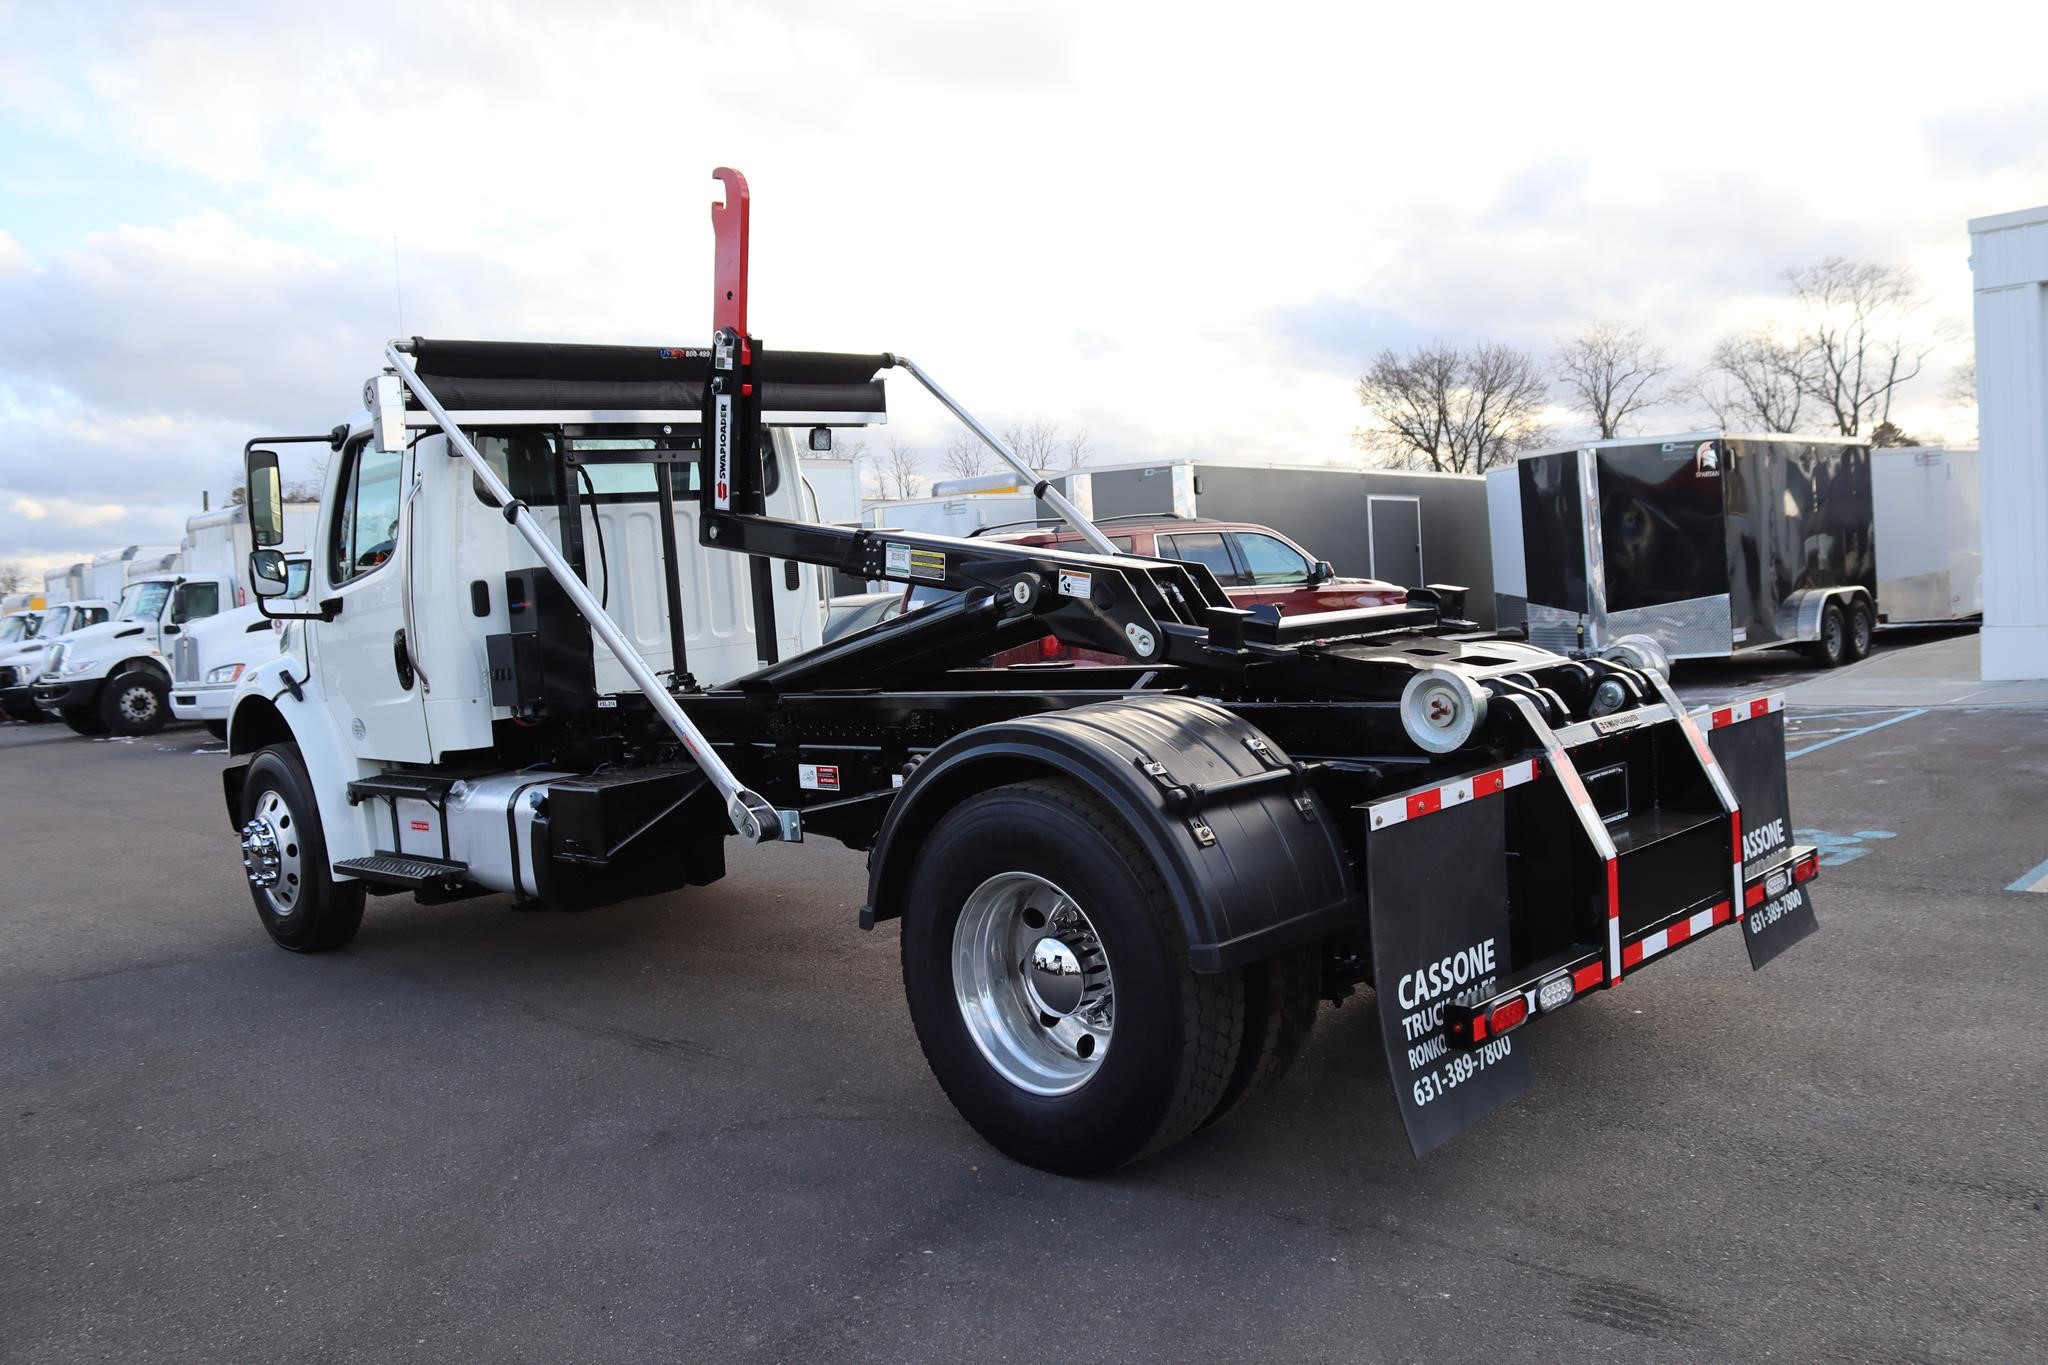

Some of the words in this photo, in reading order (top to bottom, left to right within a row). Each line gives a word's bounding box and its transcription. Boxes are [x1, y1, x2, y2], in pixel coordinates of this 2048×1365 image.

[719, 403, 728, 479] SWAPLOADER
[1695, 470, 1720, 478] SPARTAN
[1742, 818, 1786, 862] ASSONE
[1750, 889, 1802, 934] 631-389-7800
[1397, 938, 1497, 1010] CASSONE
[1408, 1034, 1452, 1071] RONKO
[1413, 1035, 1512, 1107] 631-389-7800
